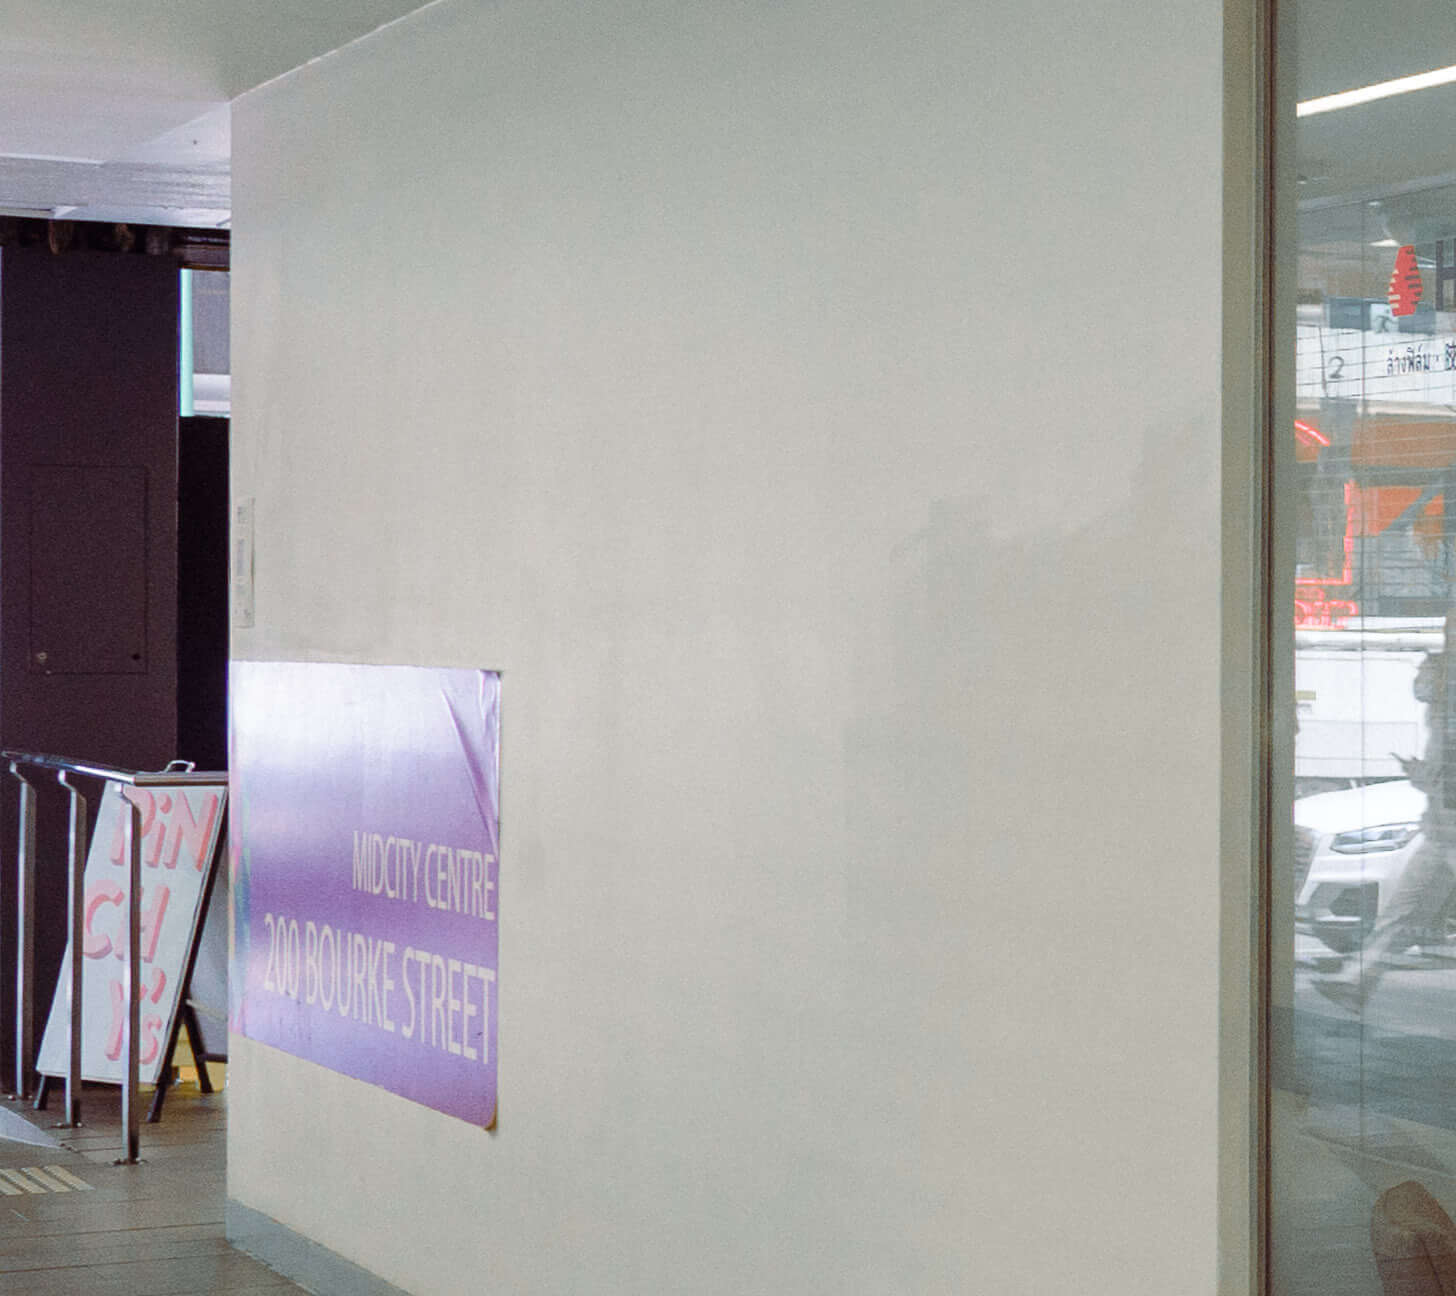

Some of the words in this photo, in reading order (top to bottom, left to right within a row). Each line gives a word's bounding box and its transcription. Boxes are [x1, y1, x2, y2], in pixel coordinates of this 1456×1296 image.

[352, 830, 422, 903] MIDCITY
[424, 842, 496, 921] CENTRE
[263, 912, 300, 1001] 200
[305, 920, 396, 1033] BOURKE
[401, 946, 496, 1065] STREET
